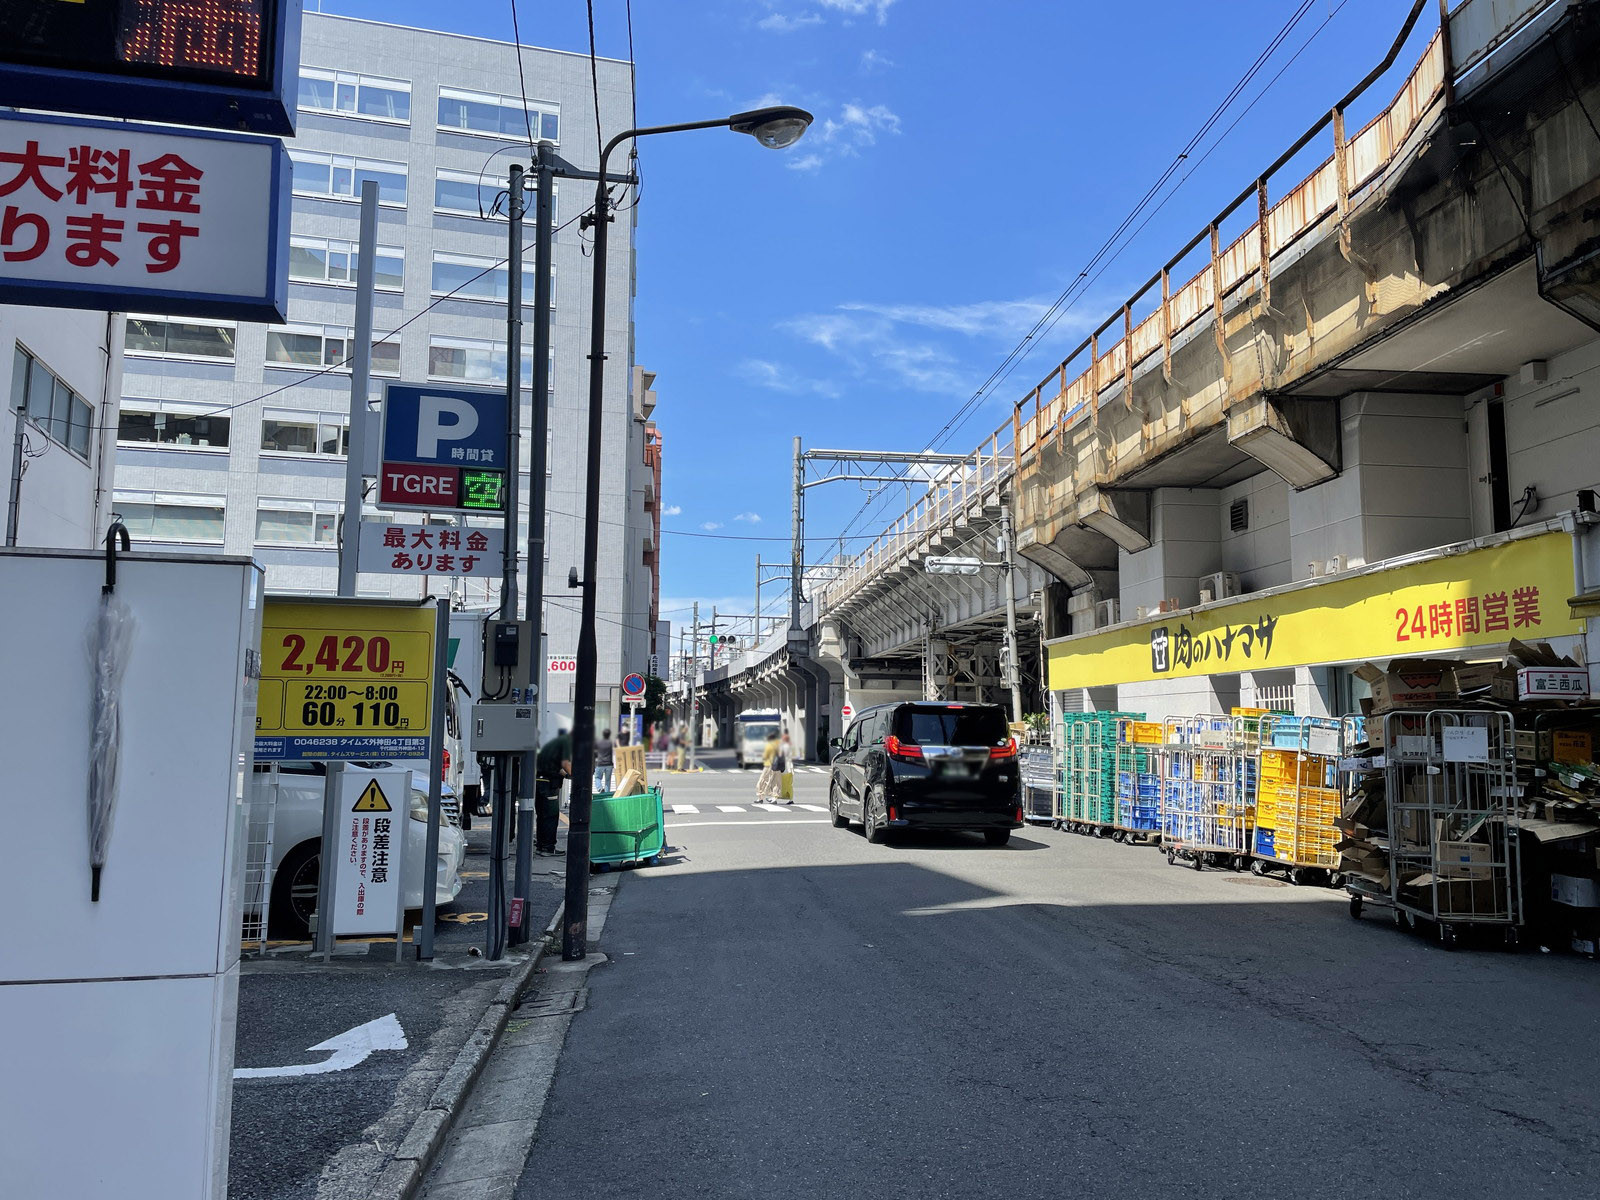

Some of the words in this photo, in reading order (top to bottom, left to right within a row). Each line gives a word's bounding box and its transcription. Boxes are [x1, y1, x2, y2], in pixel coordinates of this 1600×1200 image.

[0, 140, 204, 214] 大料金
[0, 205, 200, 274] ります
[416, 395, 479, 459] P
[451, 447, 494, 463] 時間貸
[387, 473, 454, 496] TGRE
[464, 473, 501, 508] 空
[383, 527, 489, 552] 最大料金
[391, 552, 481, 573] あります
[1395, 586, 1542, 642] 24時間営業
[281, 634, 405, 675] 2,420円
[1173, 614, 1279, 671] 肉のハナマサ
[294, 738, 338, 746] 0046238
[340, 738, 425, 747] タイムズ外神田4丁目第3
[371, 818, 391, 883] 段差注意
